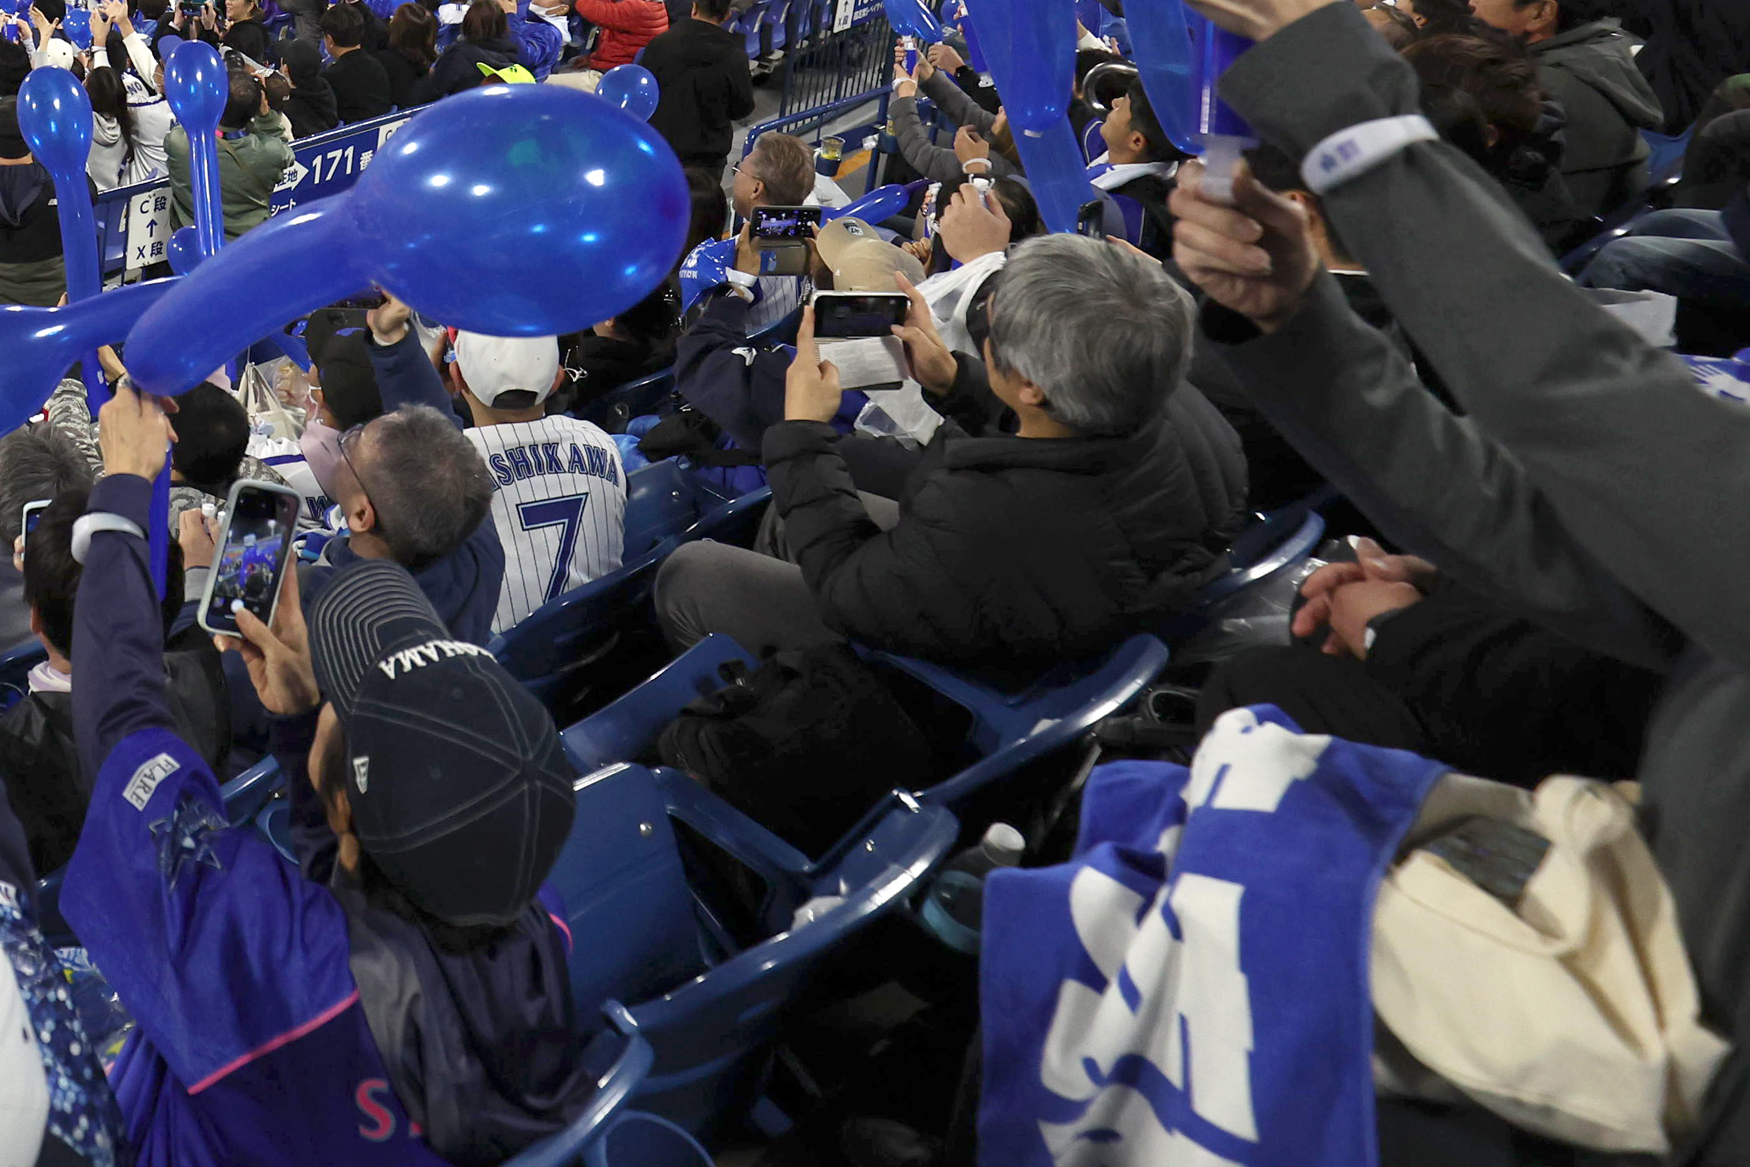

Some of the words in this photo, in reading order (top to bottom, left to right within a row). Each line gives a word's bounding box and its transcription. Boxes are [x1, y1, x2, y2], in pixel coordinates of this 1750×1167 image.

[312, 145, 355, 184] 171
[515, 492, 589, 605] 7
[127, 757, 178, 809] FLARE
